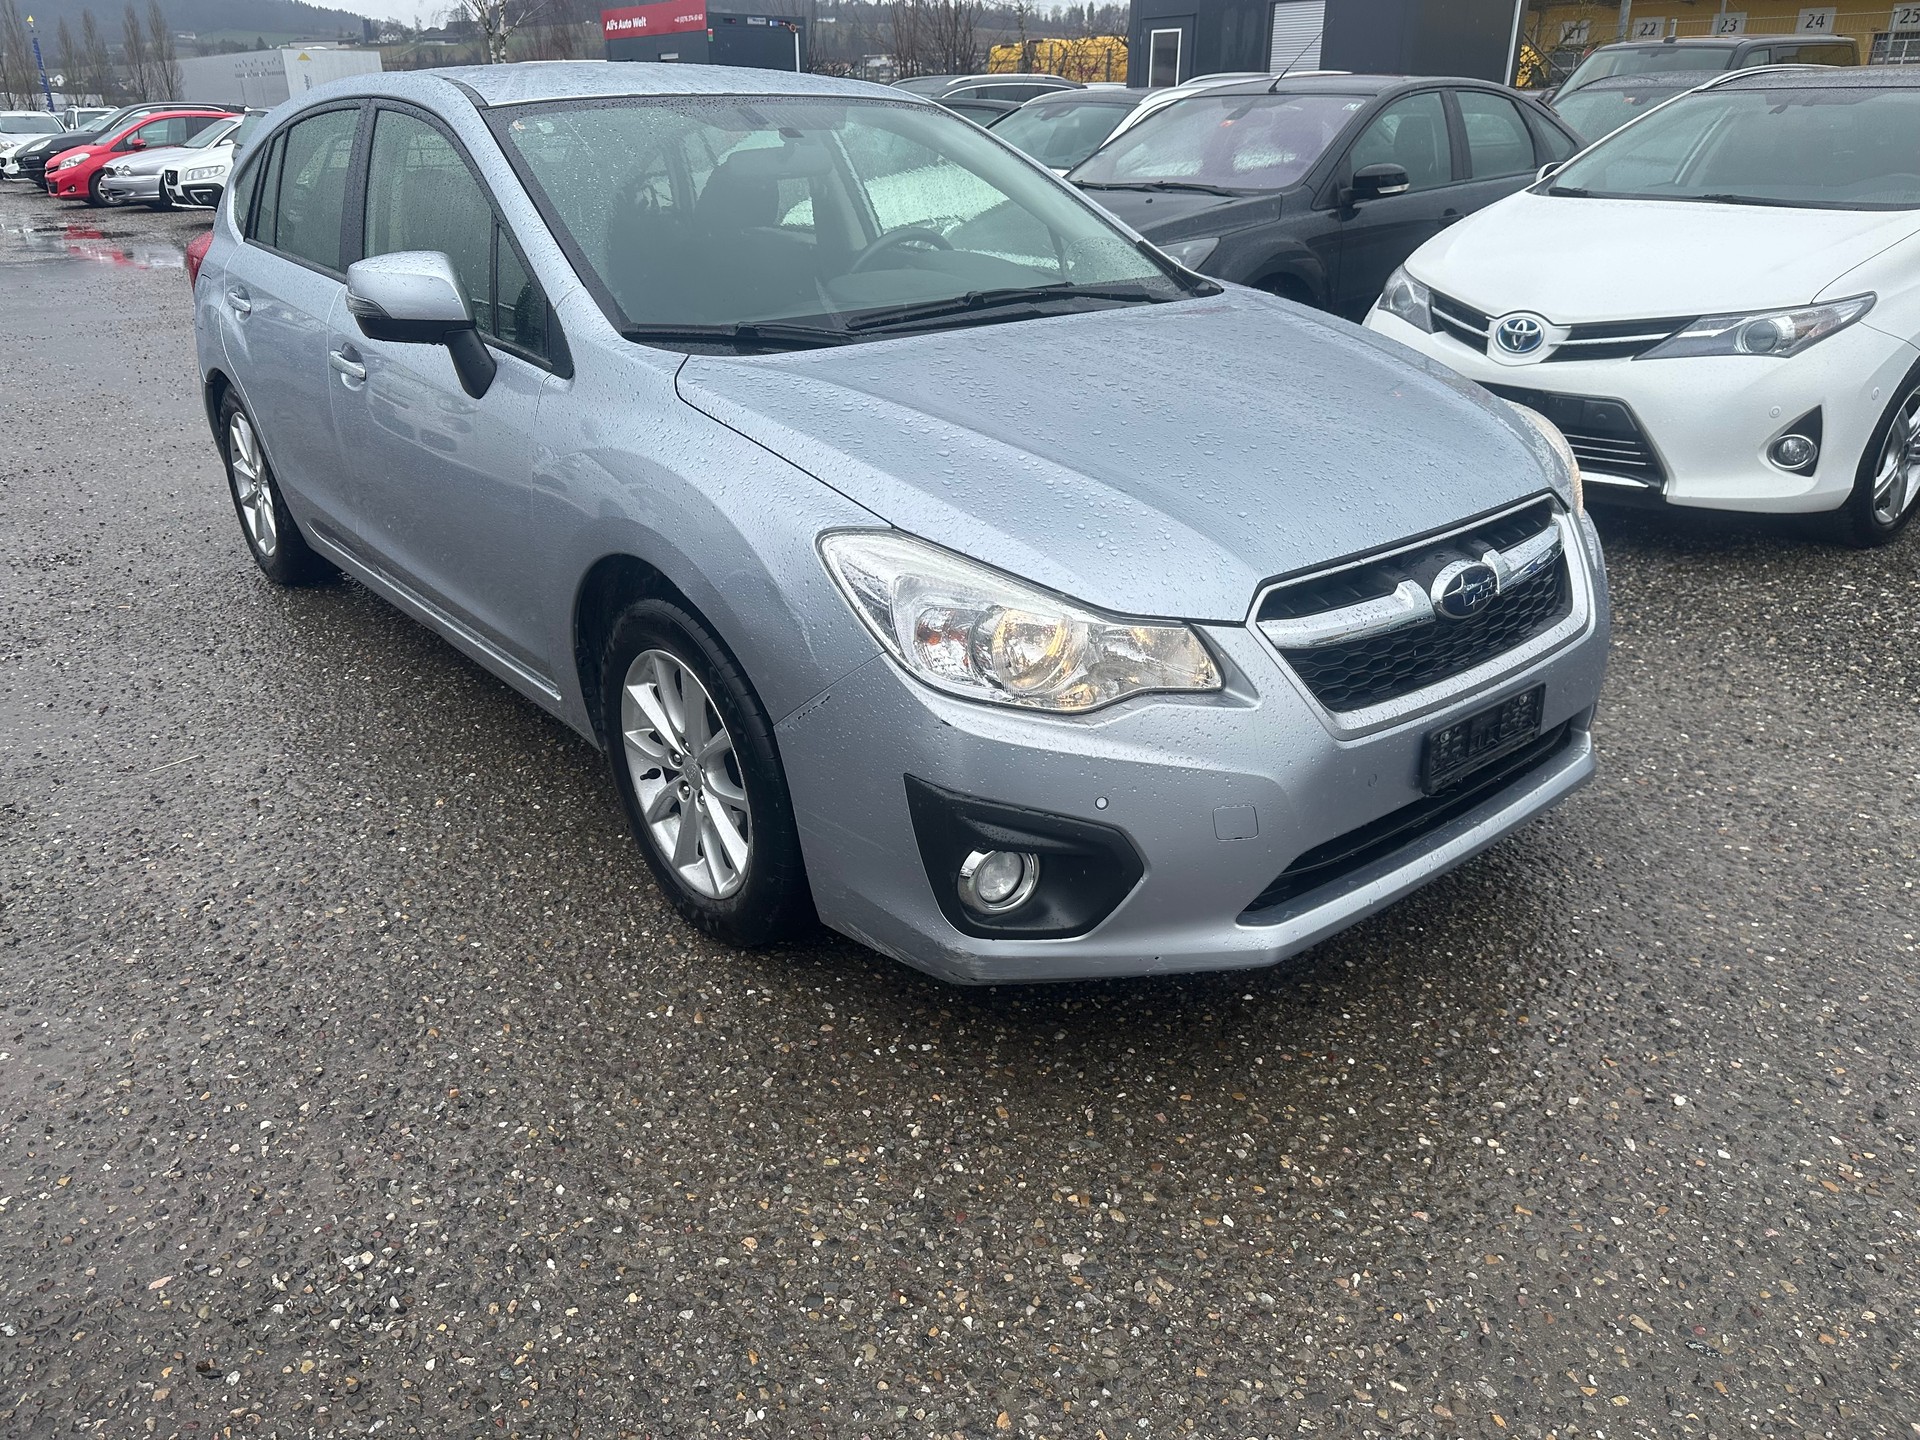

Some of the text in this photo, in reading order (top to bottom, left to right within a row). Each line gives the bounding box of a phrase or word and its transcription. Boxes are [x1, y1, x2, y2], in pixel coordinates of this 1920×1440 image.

[618, 18, 632, 30] Auto
[632, 16, 647, 28] Welt
[1639, 21, 1657, 36] 22
[1720, 17, 1738, 33] 23
[1805, 13, 1825, 29] 24
